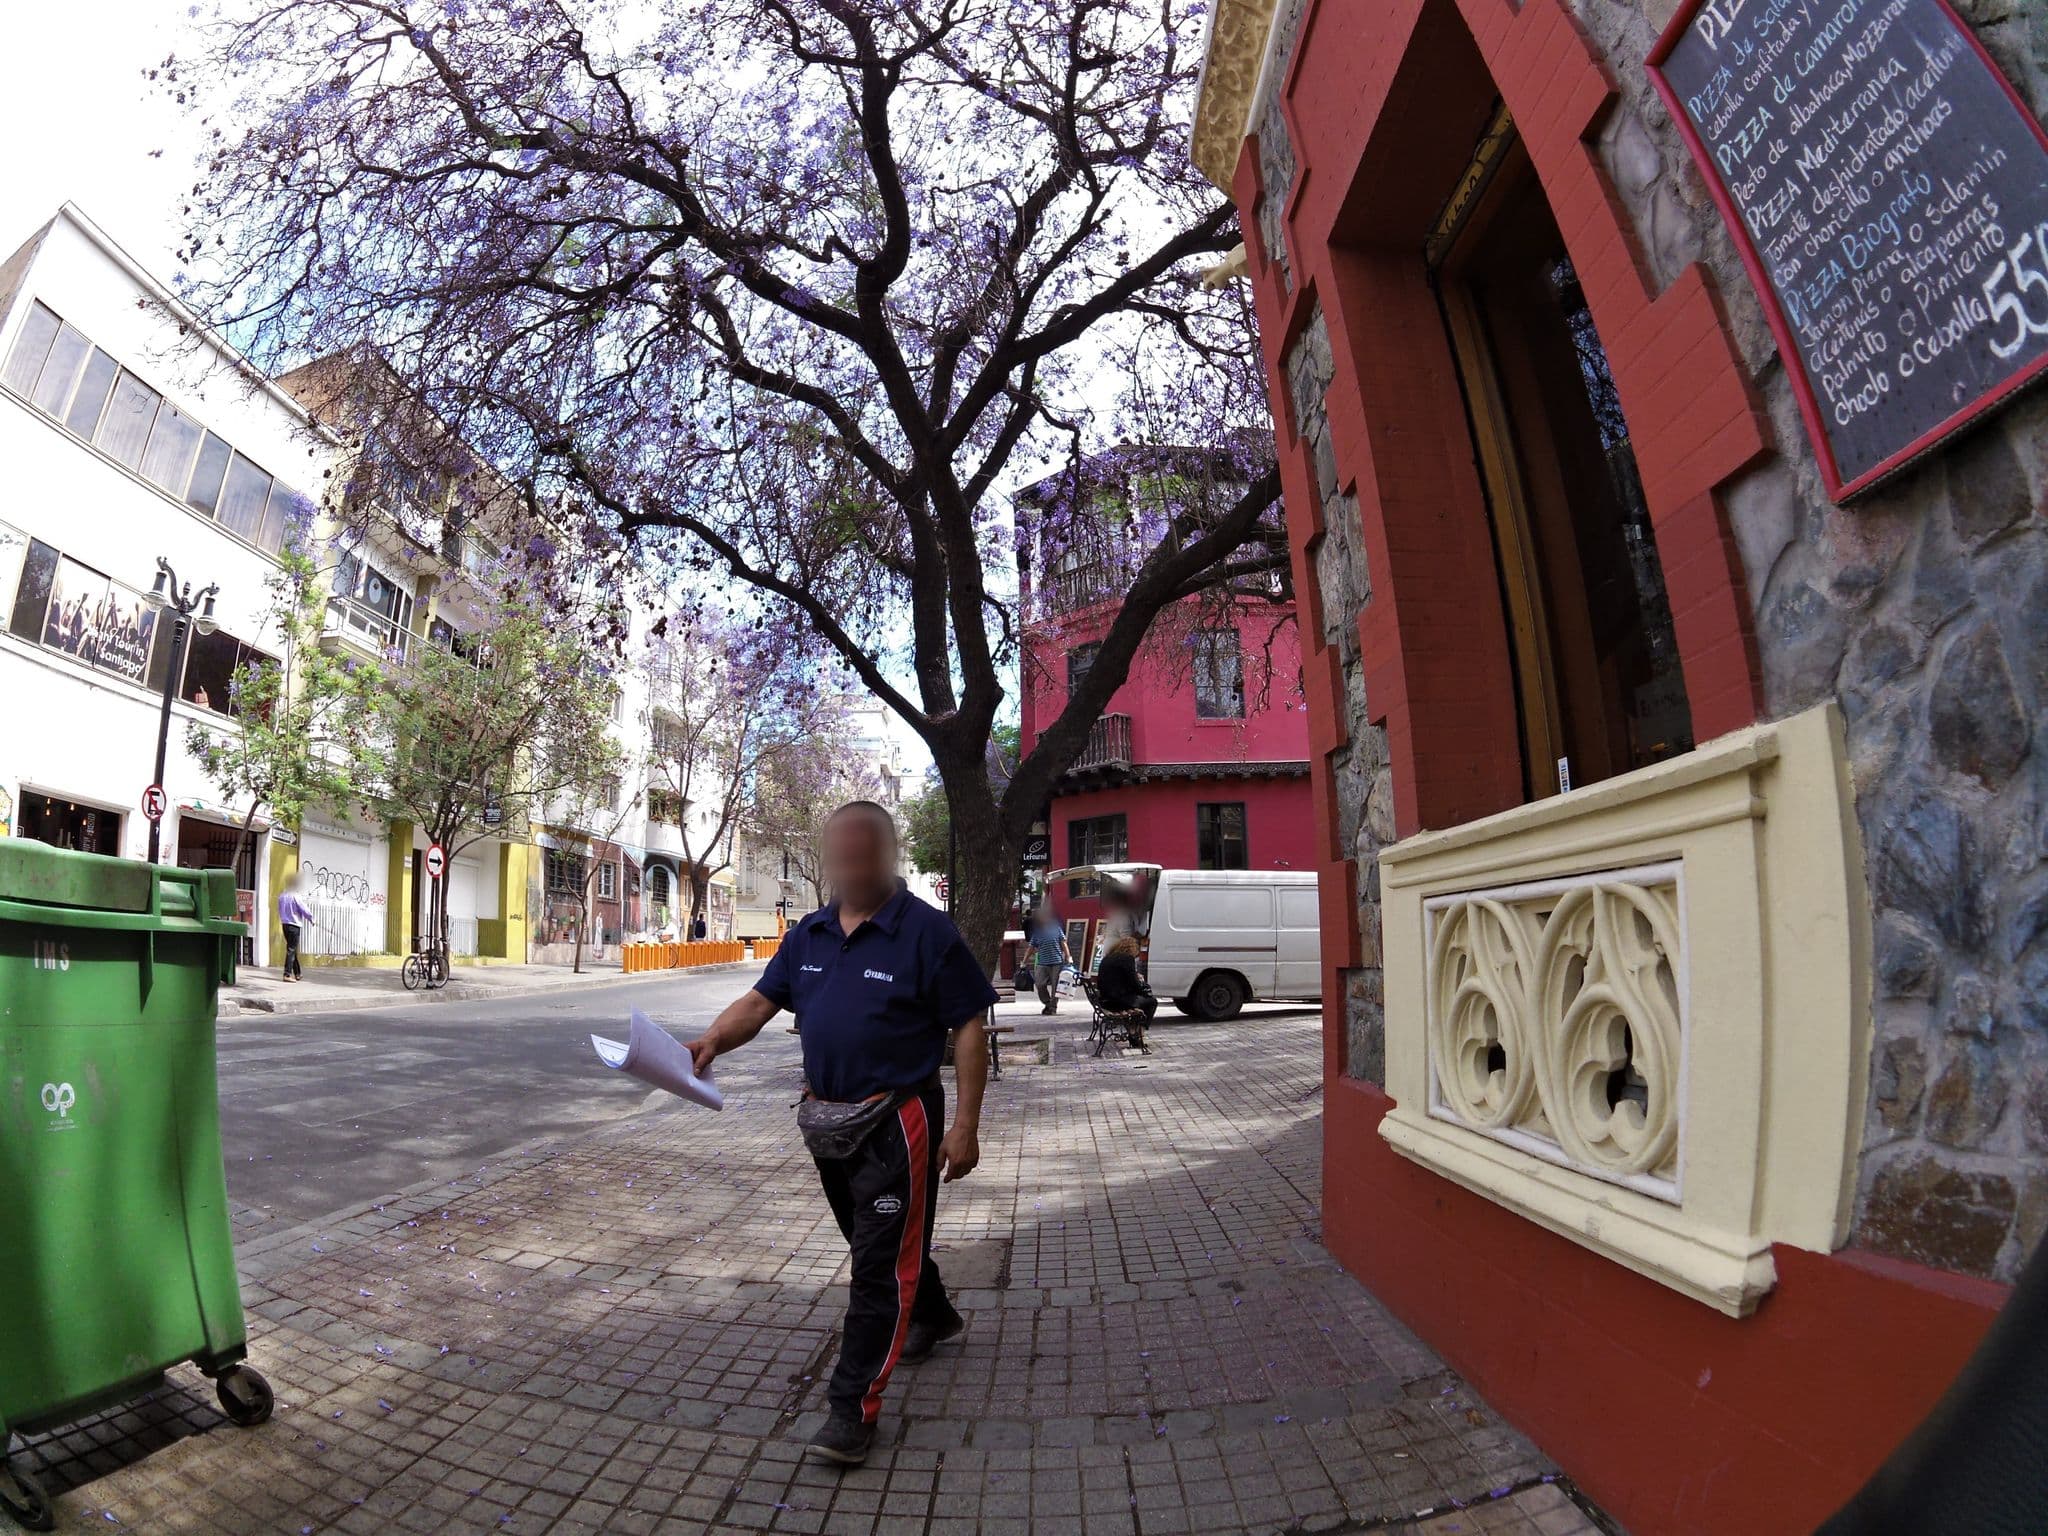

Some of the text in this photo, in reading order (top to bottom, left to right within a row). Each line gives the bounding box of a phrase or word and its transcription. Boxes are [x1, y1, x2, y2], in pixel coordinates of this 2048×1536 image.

[1731, 36, 1754, 66] de
[1773, 74, 1797, 104] de
[1768, 138, 1790, 165] de
[1871, 170, 1885, 187] o
[99, 647, 142, 674] Santiago
